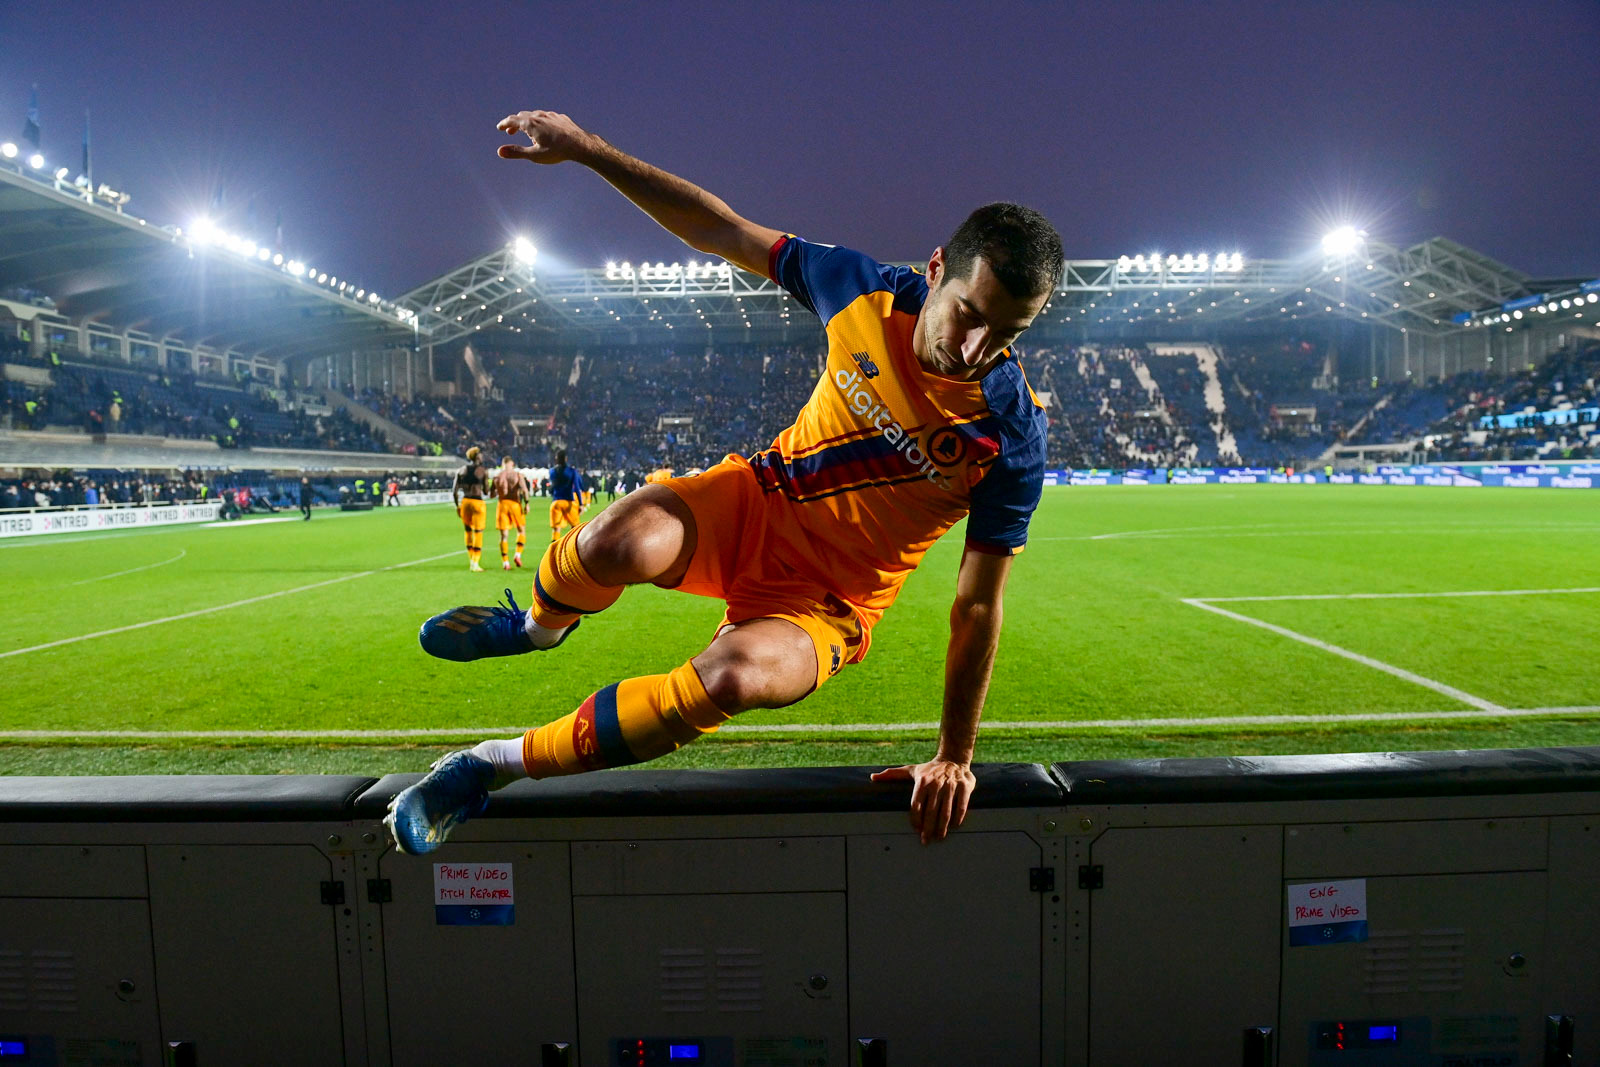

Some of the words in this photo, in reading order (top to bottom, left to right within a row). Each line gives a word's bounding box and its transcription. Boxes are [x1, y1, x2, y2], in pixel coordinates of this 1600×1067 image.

[105, 511, 136, 525] INTRED
[150, 509, 178, 520] INTRED
[0, 518, 33, 532] TRED
[52, 515, 88, 529] INTRED
[440, 865, 469, 880] PRIME
[475, 866, 508, 881] VIDEO
[470, 886, 511, 900] REPORTER
[1309, 886, 1338, 899] ENG
[1330, 904, 1359, 919] VIDEO
